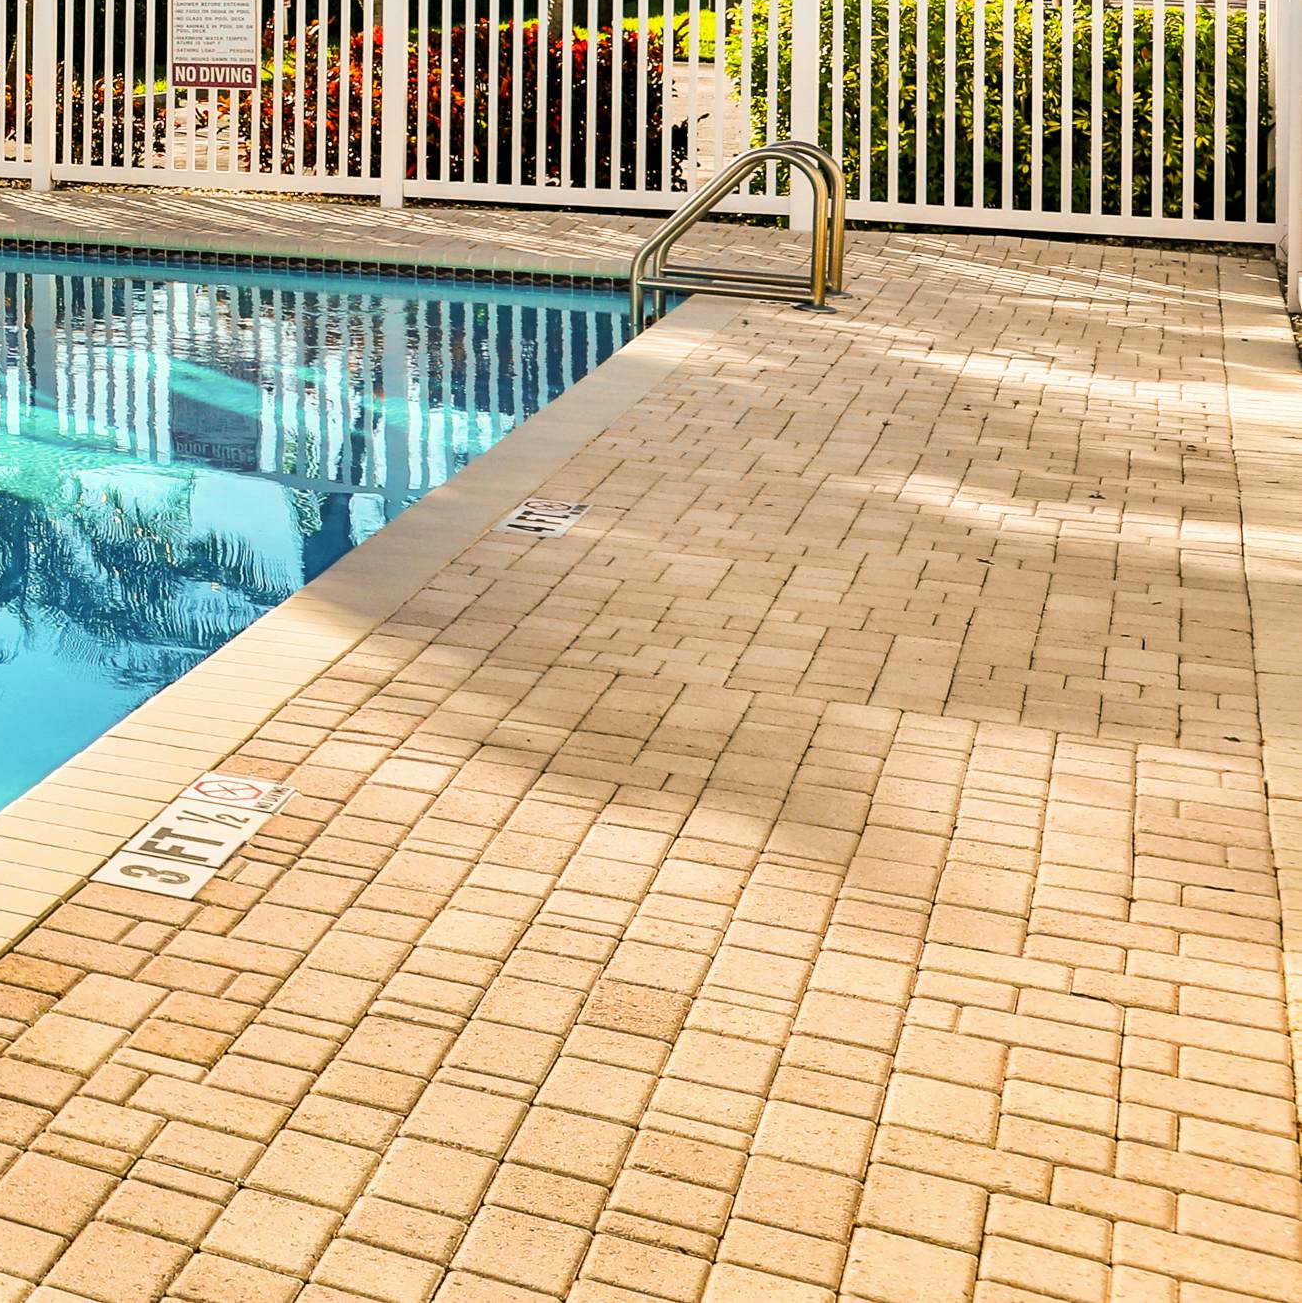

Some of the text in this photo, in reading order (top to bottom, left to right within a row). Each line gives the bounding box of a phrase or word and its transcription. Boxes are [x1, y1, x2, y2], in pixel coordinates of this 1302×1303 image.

[175, 66, 253, 84] NO DIVING
[139, 826, 224, 863] FT
[120, 864, 190, 885] 3
